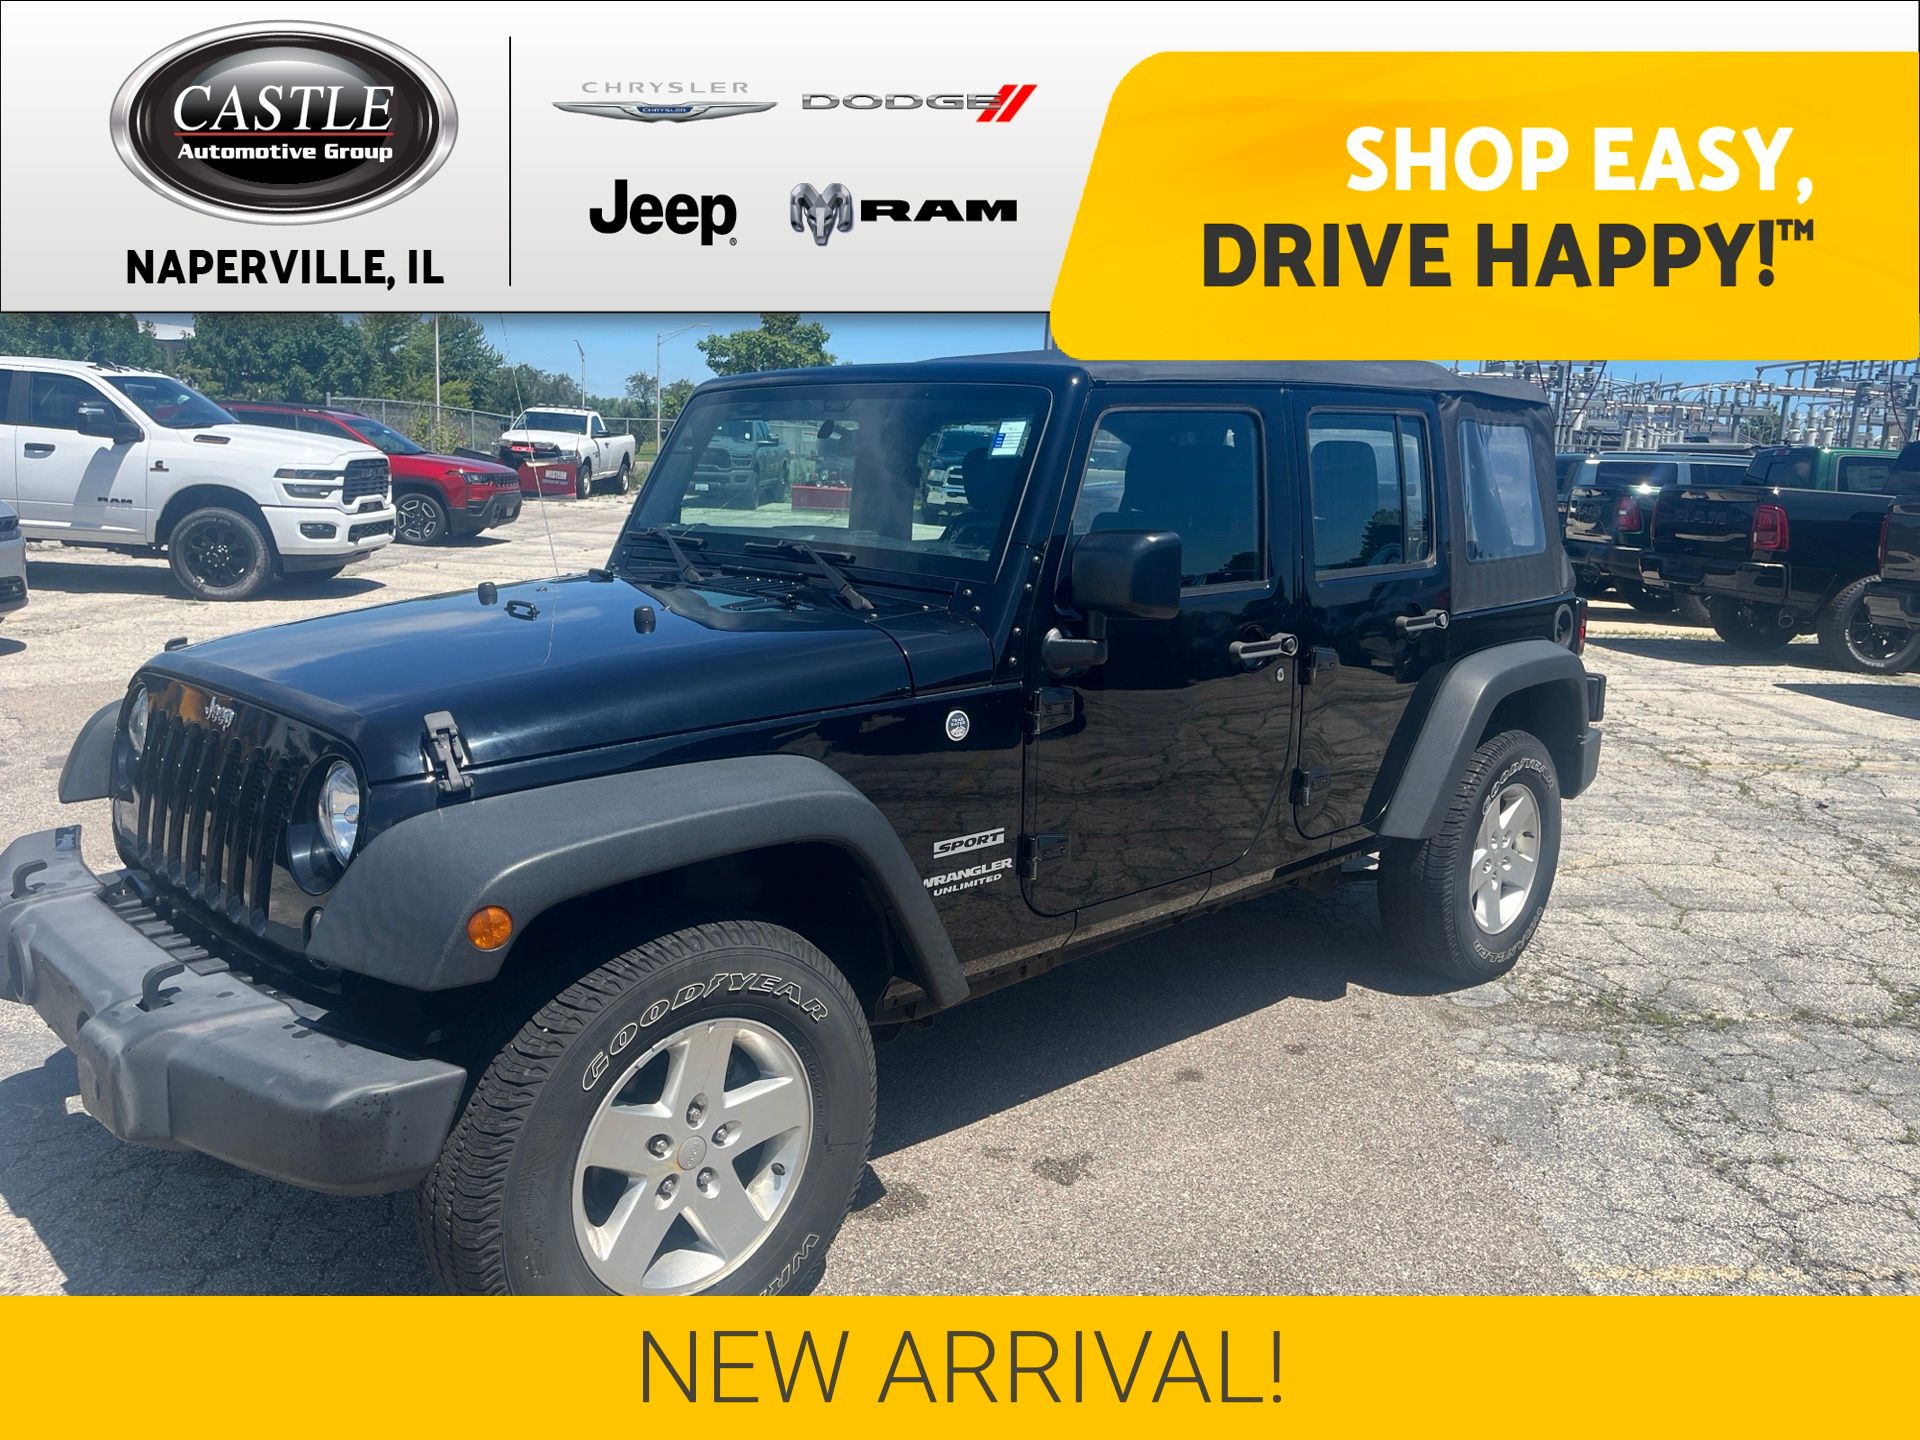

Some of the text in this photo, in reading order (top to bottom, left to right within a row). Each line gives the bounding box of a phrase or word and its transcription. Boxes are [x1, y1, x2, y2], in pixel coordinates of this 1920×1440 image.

[97, 496, 133, 505] RAM
[1674, 508, 1728, 526] RAM
[204, 696, 236, 731] Jeep
[937, 831, 1001, 855] SPORT
[933, 873, 1002, 897] UNLIMITED
[582, 972, 829, 1092] GOODYEAR
